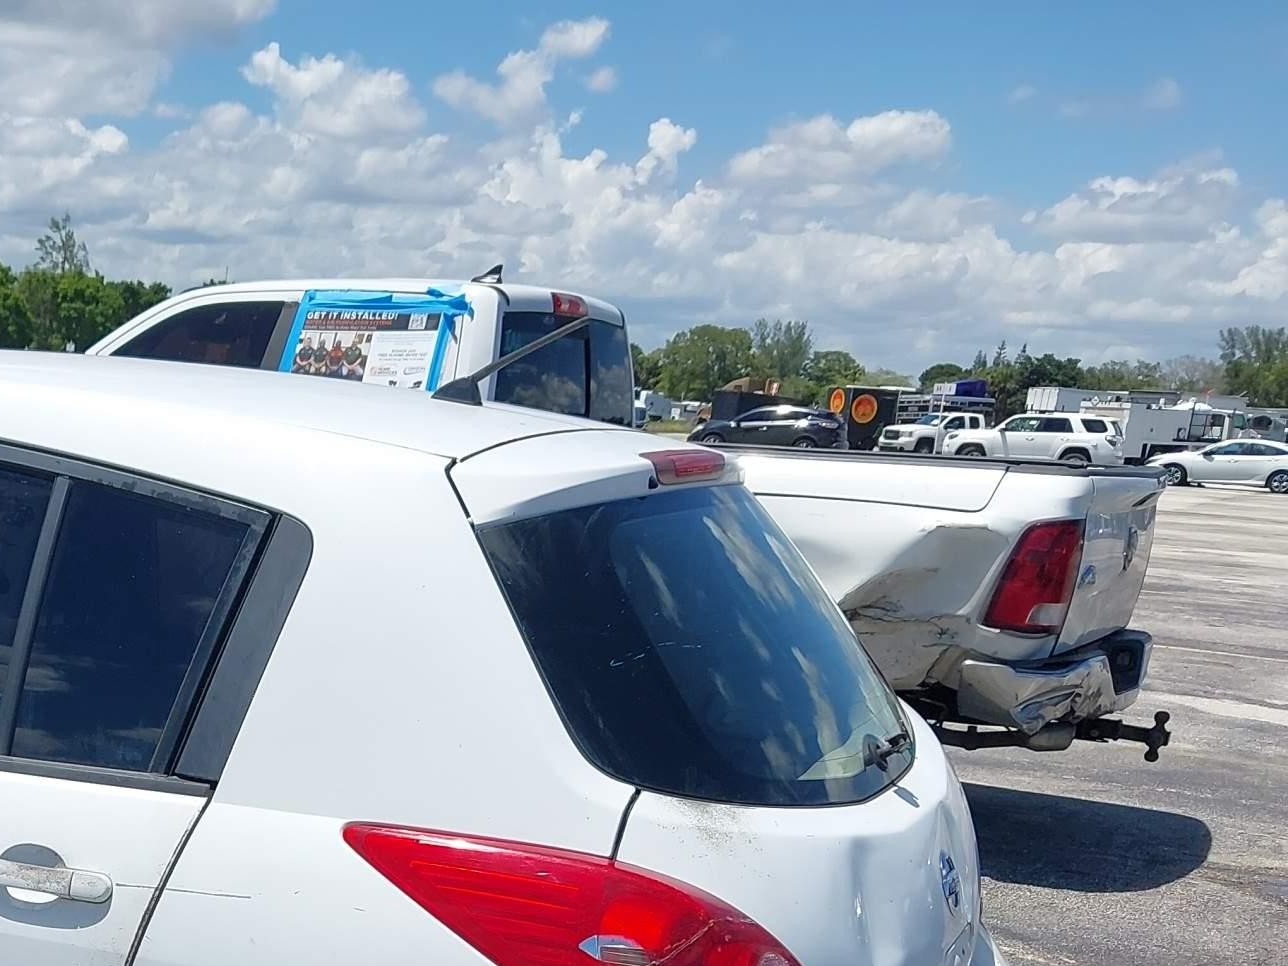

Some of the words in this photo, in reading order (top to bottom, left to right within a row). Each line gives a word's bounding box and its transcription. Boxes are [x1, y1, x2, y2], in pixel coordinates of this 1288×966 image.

[307, 311, 326, 320] GET
[328, 311, 337, 320] IT
[340, 311, 399, 320] INSTALLED!
